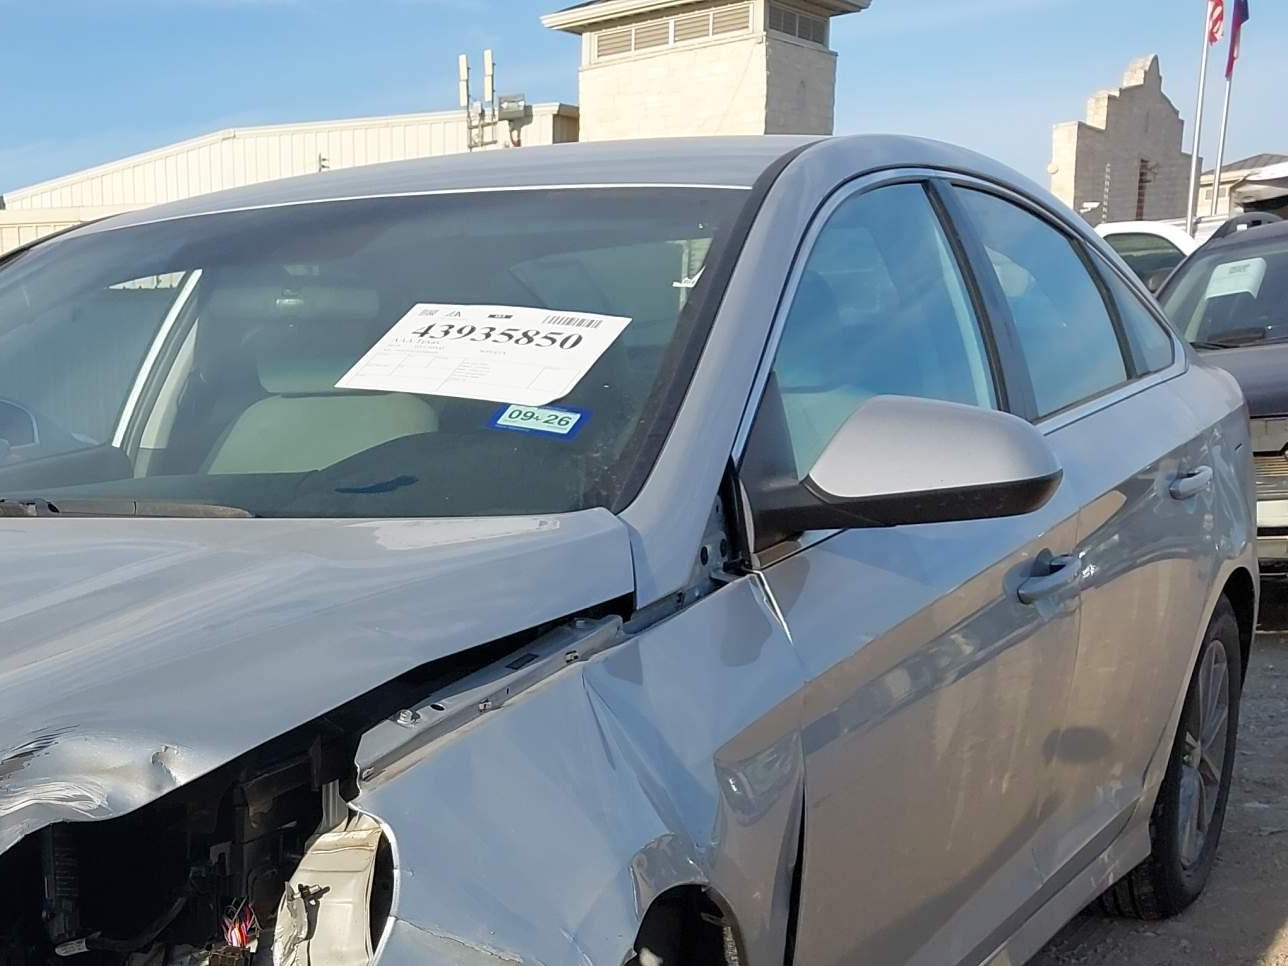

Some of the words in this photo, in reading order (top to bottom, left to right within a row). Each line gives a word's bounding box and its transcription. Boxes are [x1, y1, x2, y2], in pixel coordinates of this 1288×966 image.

[412, 322, 583, 350] 43935850
[508, 409, 535, 421] 09
[542, 414, 572, 427] 26
